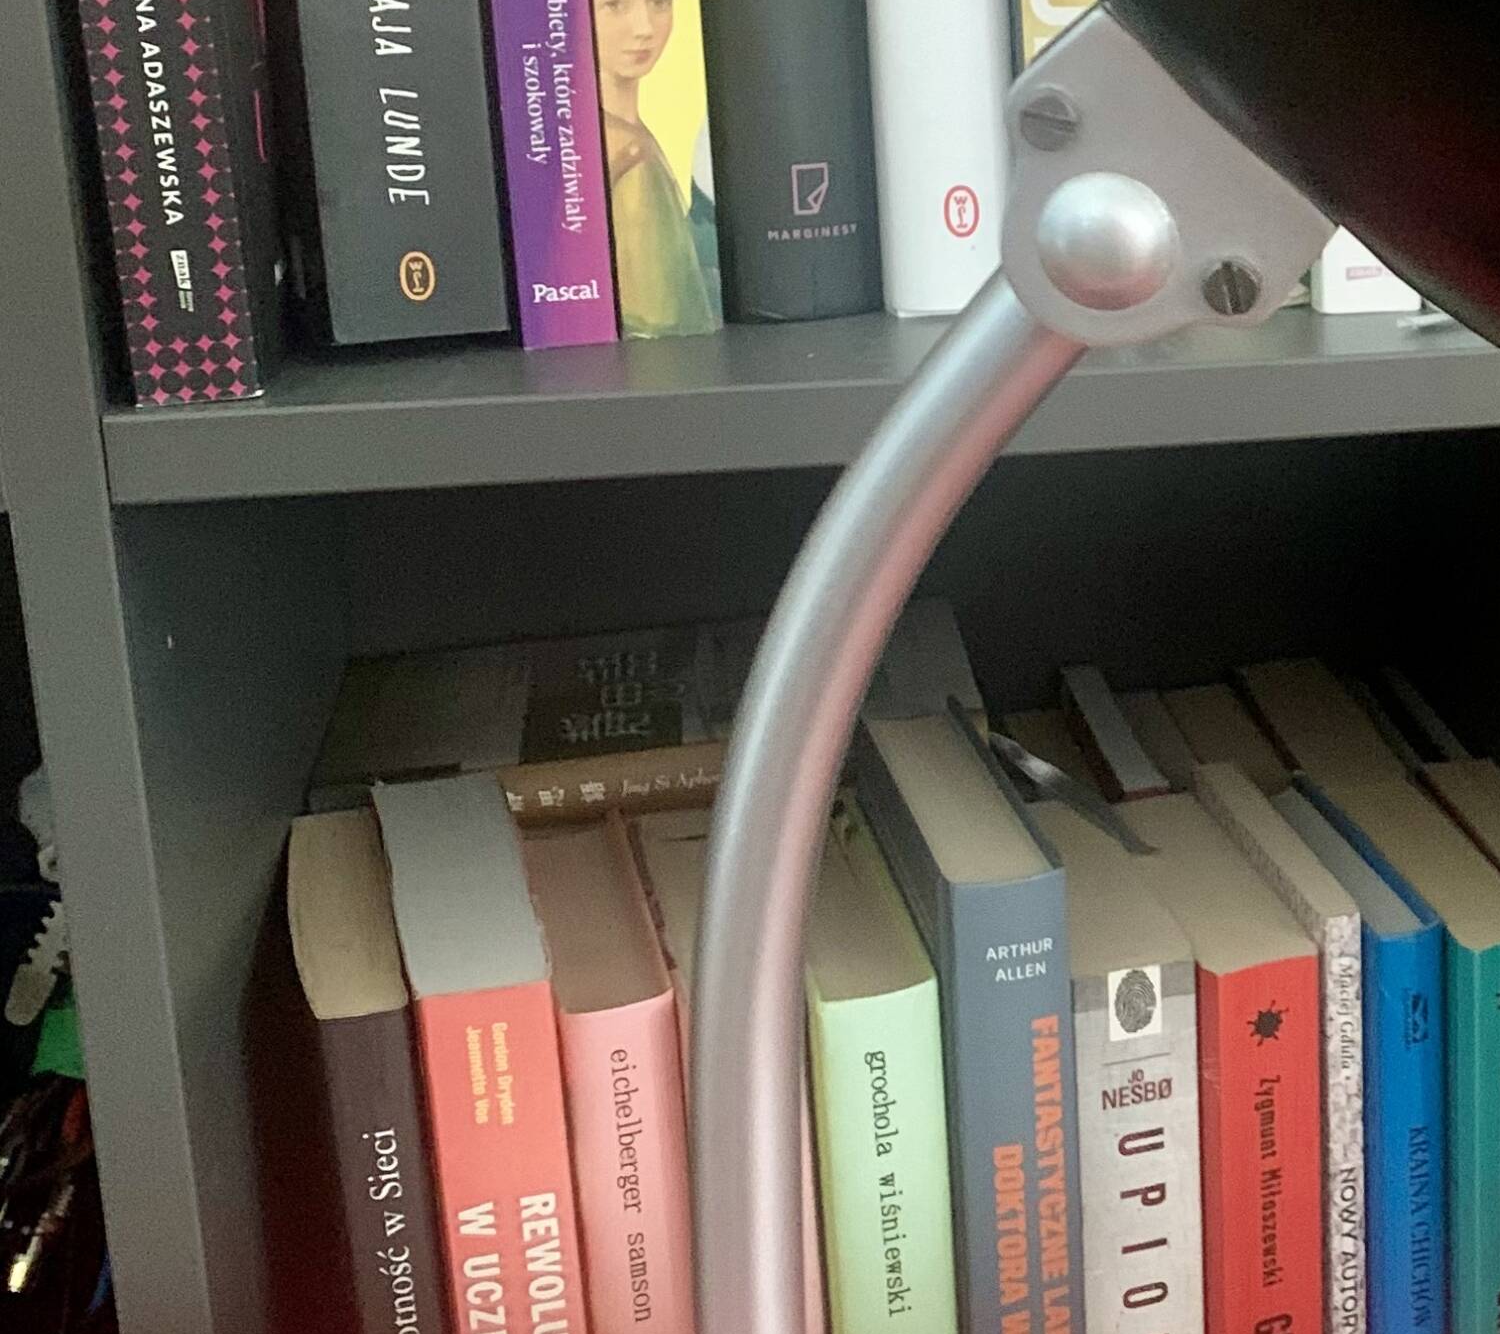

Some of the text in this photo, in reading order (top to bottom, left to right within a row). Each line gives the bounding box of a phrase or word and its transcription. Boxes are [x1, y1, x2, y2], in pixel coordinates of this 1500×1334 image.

[522, 57, 548, 166] szokowały
[552, 62, 573, 120] które
[138, 41, 185, 227] ADASZEWSKA
[379, 87, 430, 206] LUNDE
[556, 125, 584, 234] zadziwiały
[767, 222, 859, 242] MARGINESY
[532, 280, 600, 304] Pascal
[985, 936, 1054, 963] ARTHUR
[994, 960, 1047, 983] ALLEN
[864, 1049, 899, 1158] grochola
[1101, 1077, 1174, 1111] NESBØ
[1127, 1068, 1145, 1084] JO
[363, 1127, 403, 1203] Sieci
[609, 1047, 652, 1323] eichelberger samson
[1029, 1013, 1071, 1283] FANTASTYCZNE
[1254, 1074, 1284, 1289] Zygmunt Miłoszewski
[1406, 1125, 1431, 1215] KRAINA
[383, 1210, 406, 1238] w
[457, 1201, 497, 1237] W
[878, 1171, 912, 1318] wiśniewski
[991, 1143, 1030, 1306] DOKTORA
[1338, 1166, 1359, 1242] NOWY
